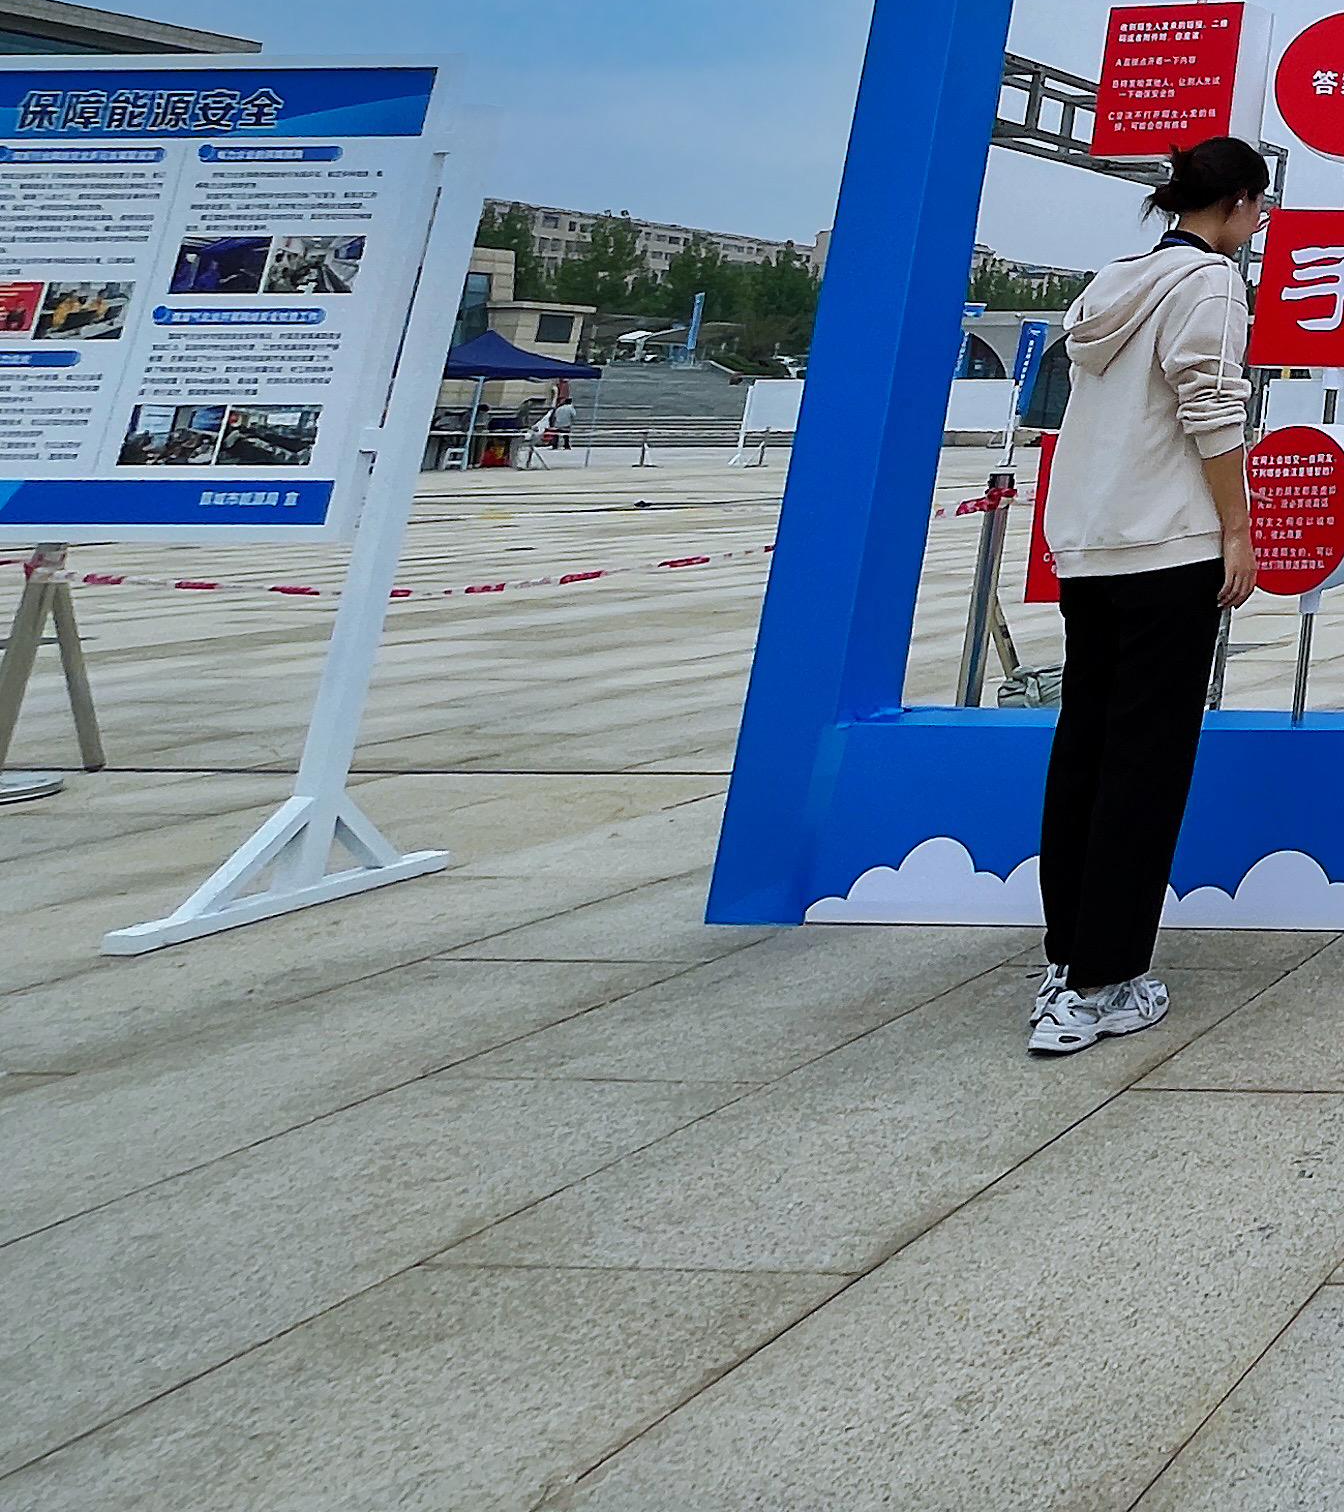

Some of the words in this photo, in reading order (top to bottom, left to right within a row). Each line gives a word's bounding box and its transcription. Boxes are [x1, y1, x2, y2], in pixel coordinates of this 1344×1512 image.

[16, 88, 285, 132] 保障能源安全
